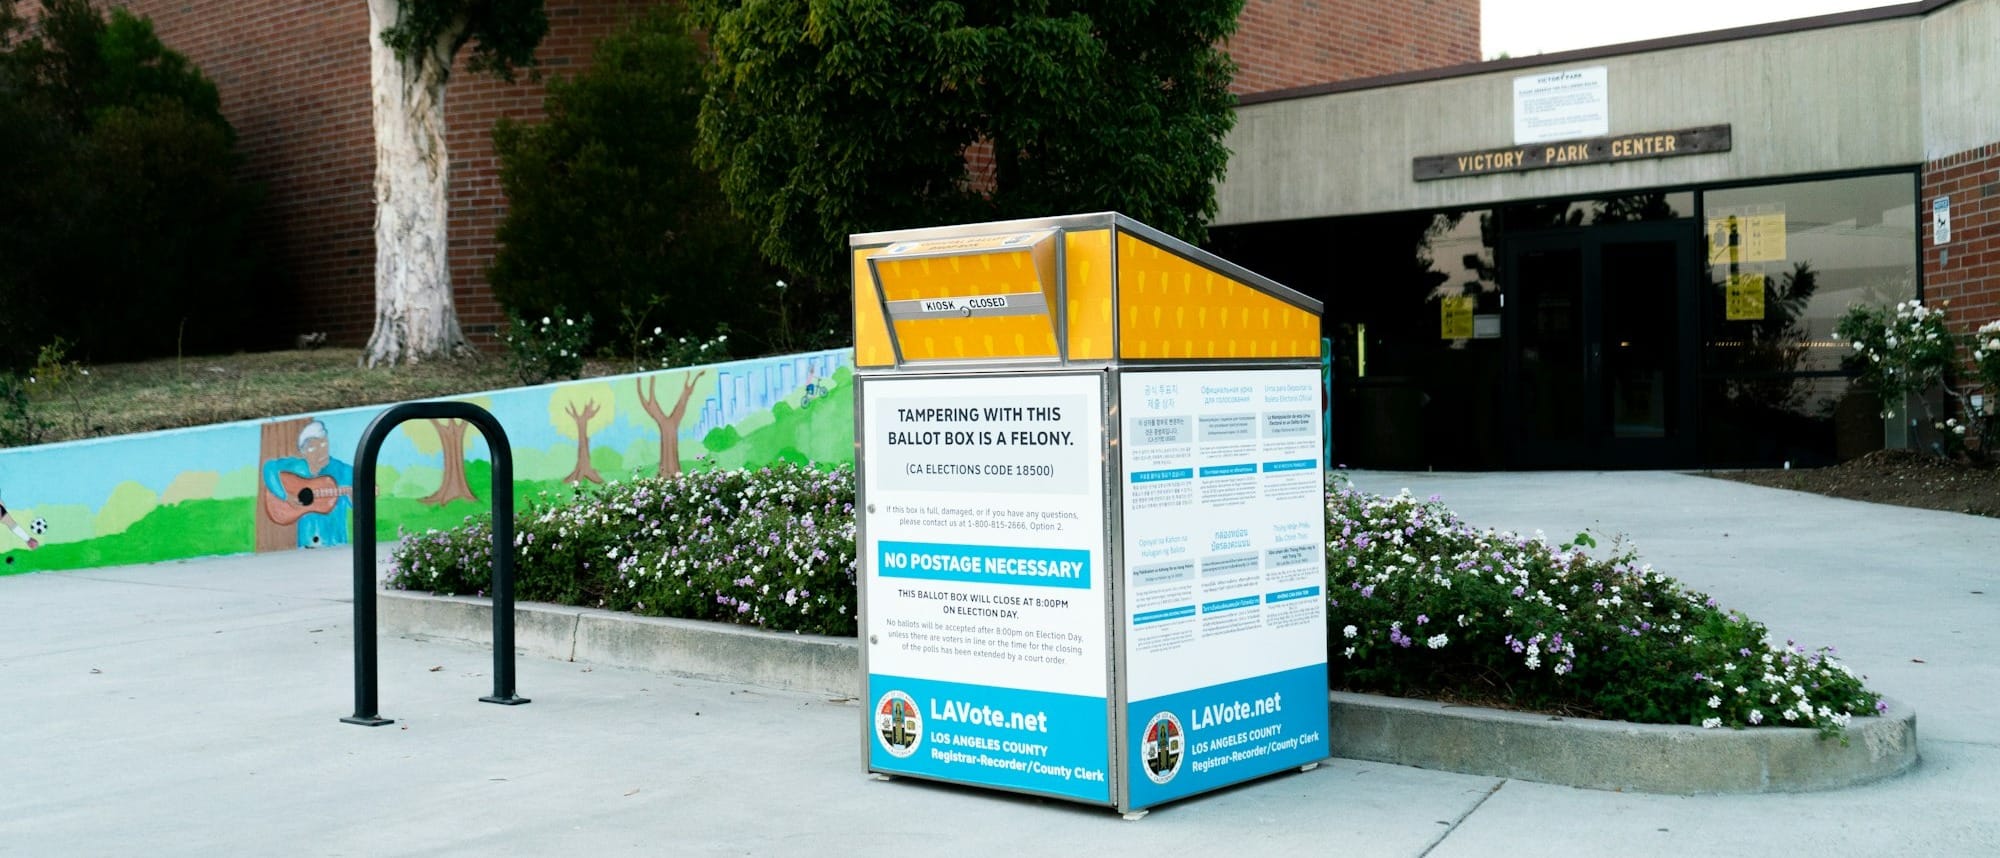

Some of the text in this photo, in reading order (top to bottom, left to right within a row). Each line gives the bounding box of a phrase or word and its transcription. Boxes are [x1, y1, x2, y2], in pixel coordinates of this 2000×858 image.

[1458, 135, 1676, 172] VICTORY PARK CENTER
[926, 298, 1005, 311] KIOSK CLOSED
[898, 407, 1061, 422] TAMPERING WITH THIS
[888, 431, 1074, 446] BALLOT BOX IS A FELONY.
[906, 463, 1054, 477] (CA ELECTIONS CODE 18500)
[886, 505, 891, 513] If
[906, 506, 918, 514] box
[926, 507, 939, 515] full,
[941, 507, 975, 517] damaged,
[986, 508, 990, 516] if
[992, 510, 1005, 518] you
[1007, 509, 1024, 517] have
[1025, 511, 1039, 520] any
[1041, 511, 1079, 521] questions,
[899, 518, 921, 526] please
[922, 518, 947, 527] contact
[1030, 522, 1055, 532] Option
[885, 552, 1083, 578] NO POSTAGE NECESSARY
[899, 589, 1069, 608] THIS BALLOT BOX WILL CLOSE AT 8:00PM
[943, 605, 1019, 619] ON ELECTION DAY.
[886, 618, 896, 626] No
[897, 619, 920, 628] ballots
[921, 621, 933, 630] will
[935, 622, 943, 630] be
[945, 624, 976, 635] accepted
[977, 625, 994, 634] after
[1036, 630, 1065, 640] Election
[888, 631, 909, 639] unless
[910, 632, 927, 641] there
[929, 634, 940, 642] are
[942, 635, 963, 644] voters
[965, 636, 971, 644] in
[973, 637, 986, 646] line
[997, 639, 1009, 648] the
[1011, 640, 1027, 649] time
[1029, 641, 1040, 650] for
[1041, 642, 1053, 651] the
[1055, 644, 1083, 656] closing
[910, 643, 921, 652] the
[923, 644, 939, 654] polls
[940, 646, 953, 655] has
[955, 647, 971, 657] been
[973, 648, 1005, 660] extended
[1007, 651, 1016, 662] by
[1025, 653, 1044, 663] court
[931, 698, 1047, 733] LAVote.net
[1192, 692, 1281, 731] LAVote.net
[931, 732, 1048, 757] LOS ANGELES COUNTY
[1192, 724, 1282, 756] LOS ANGELES COUNTY
[1192, 731, 1319, 773] Registrar-Recorder/County Clerk
[931, 749, 1104, 782] Registrar-Recorder/County Clerk
